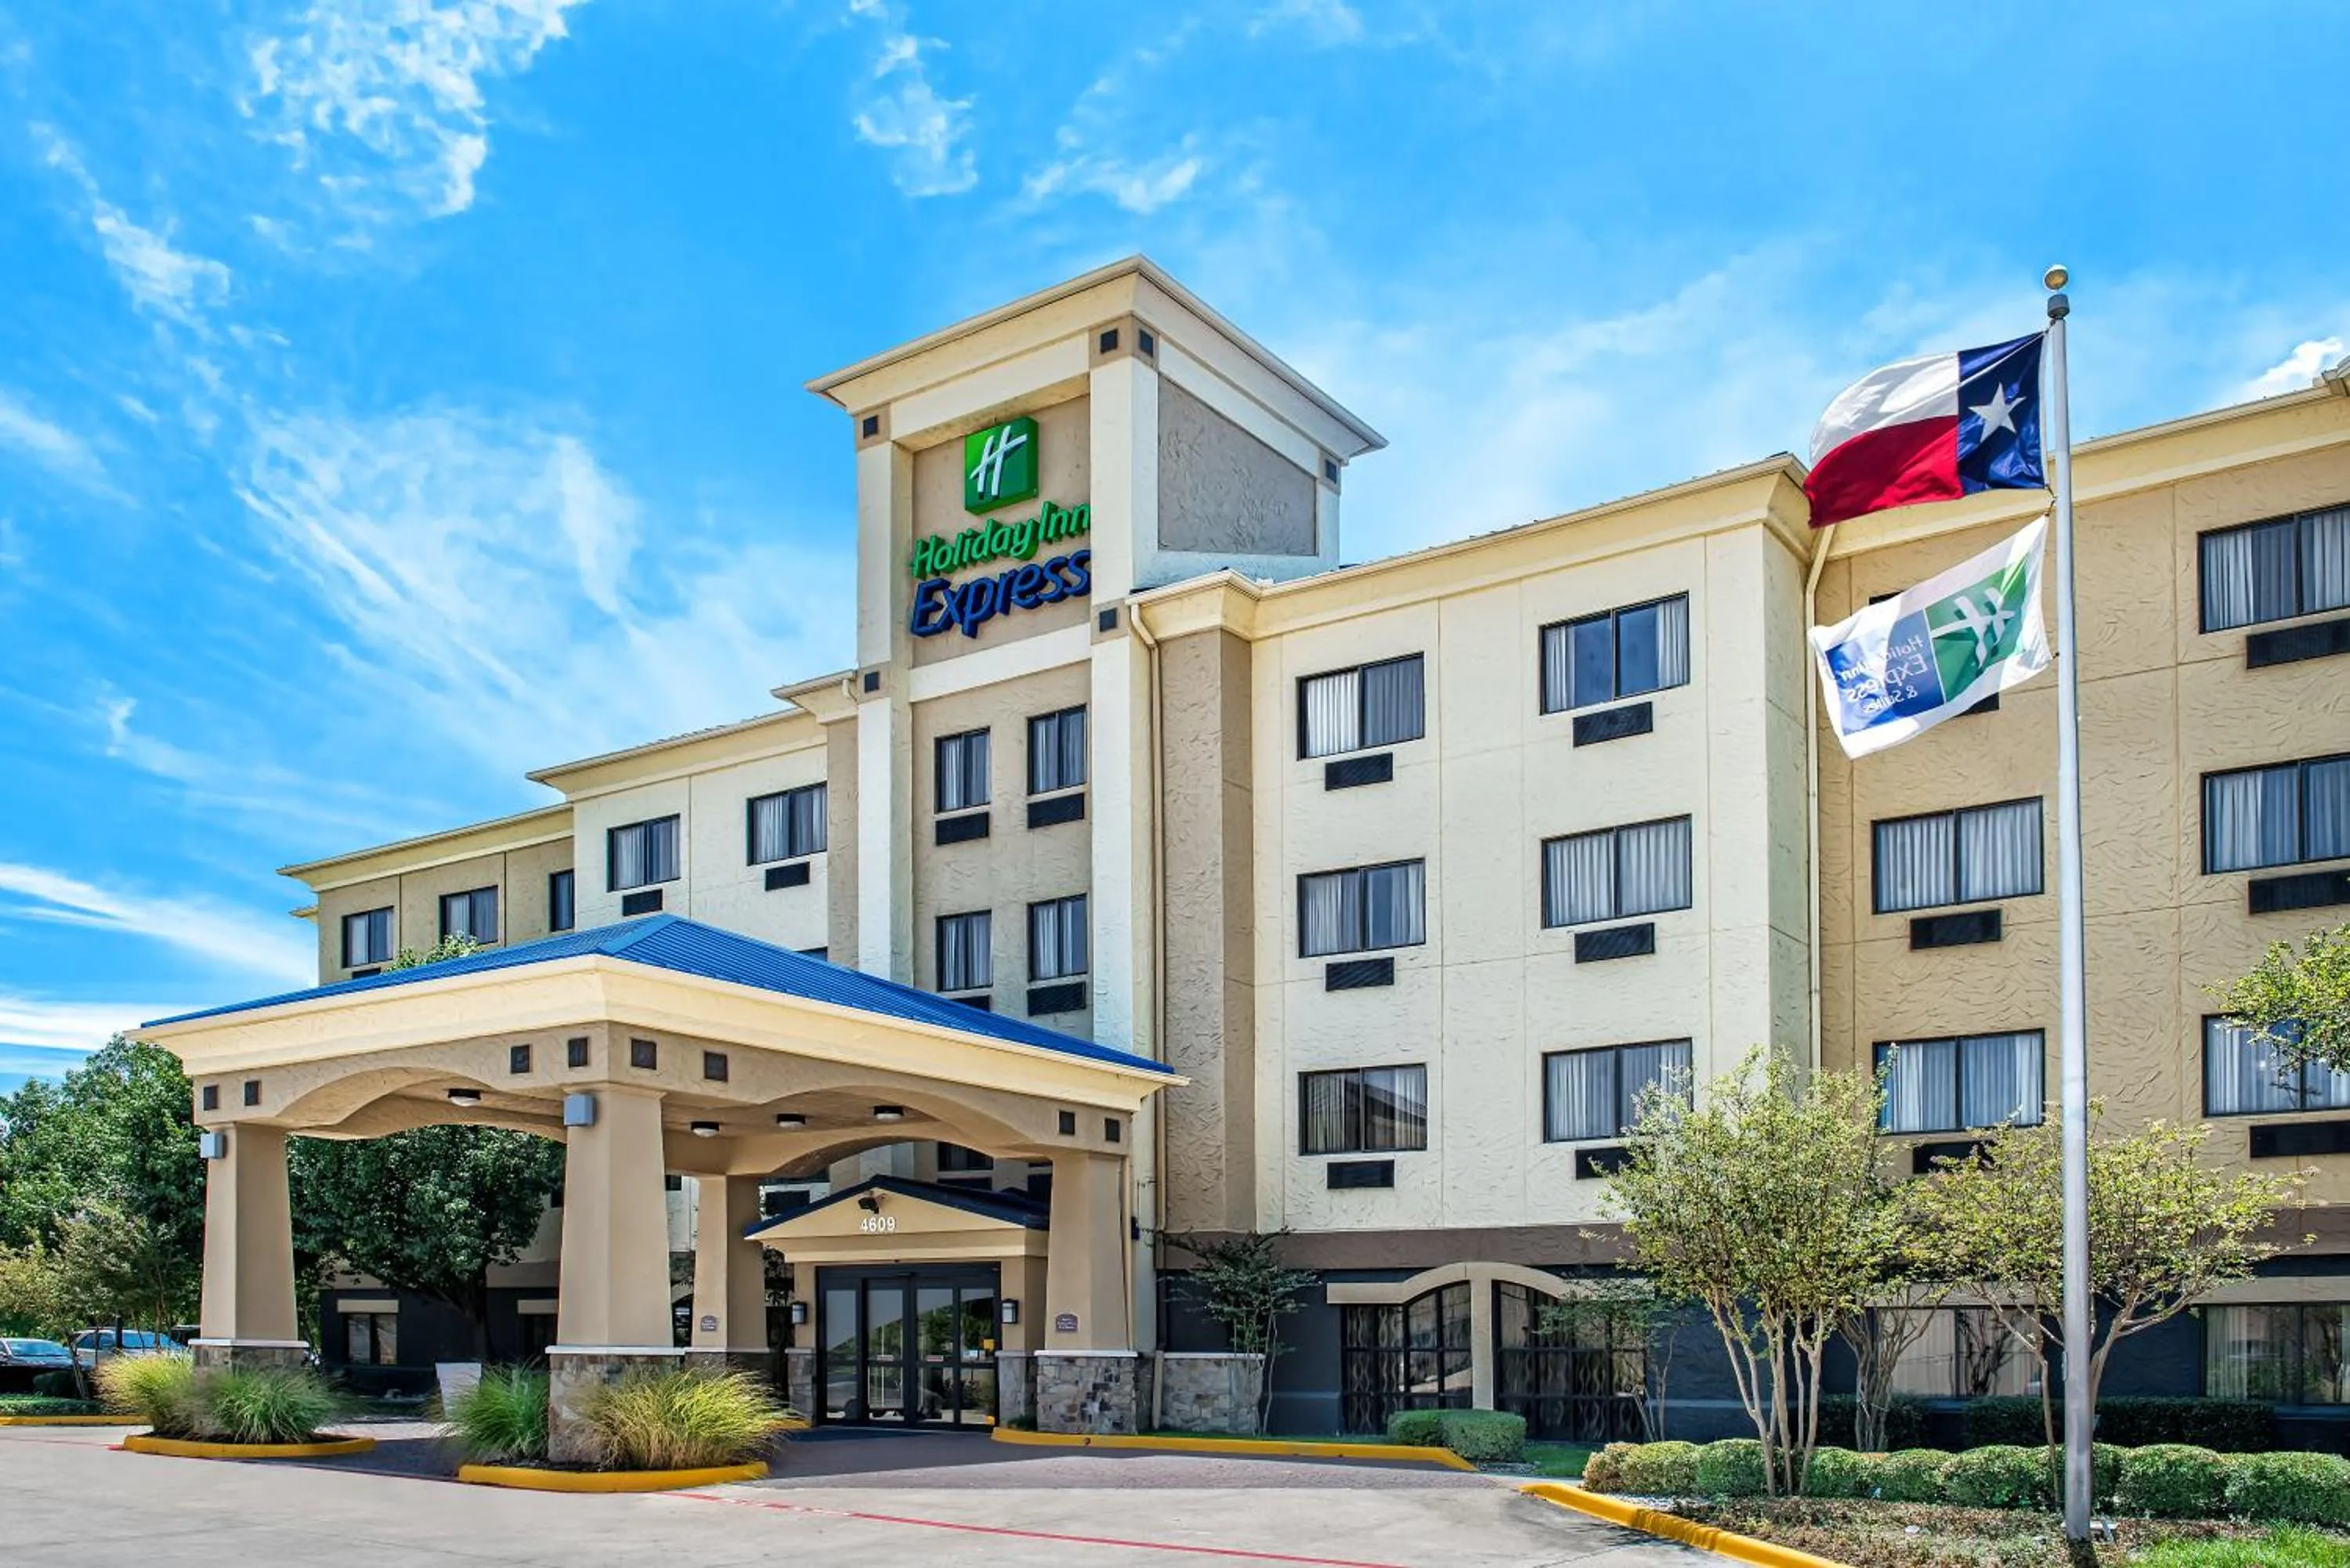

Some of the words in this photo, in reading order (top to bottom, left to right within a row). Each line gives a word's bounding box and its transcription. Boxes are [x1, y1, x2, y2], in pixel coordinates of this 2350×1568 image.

[912, 517, 1039, 579] Holiday
[1038, 500, 1090, 544] Inn
[911, 550, 1090, 638] Express
[861, 1216, 895, 1232] 4609
